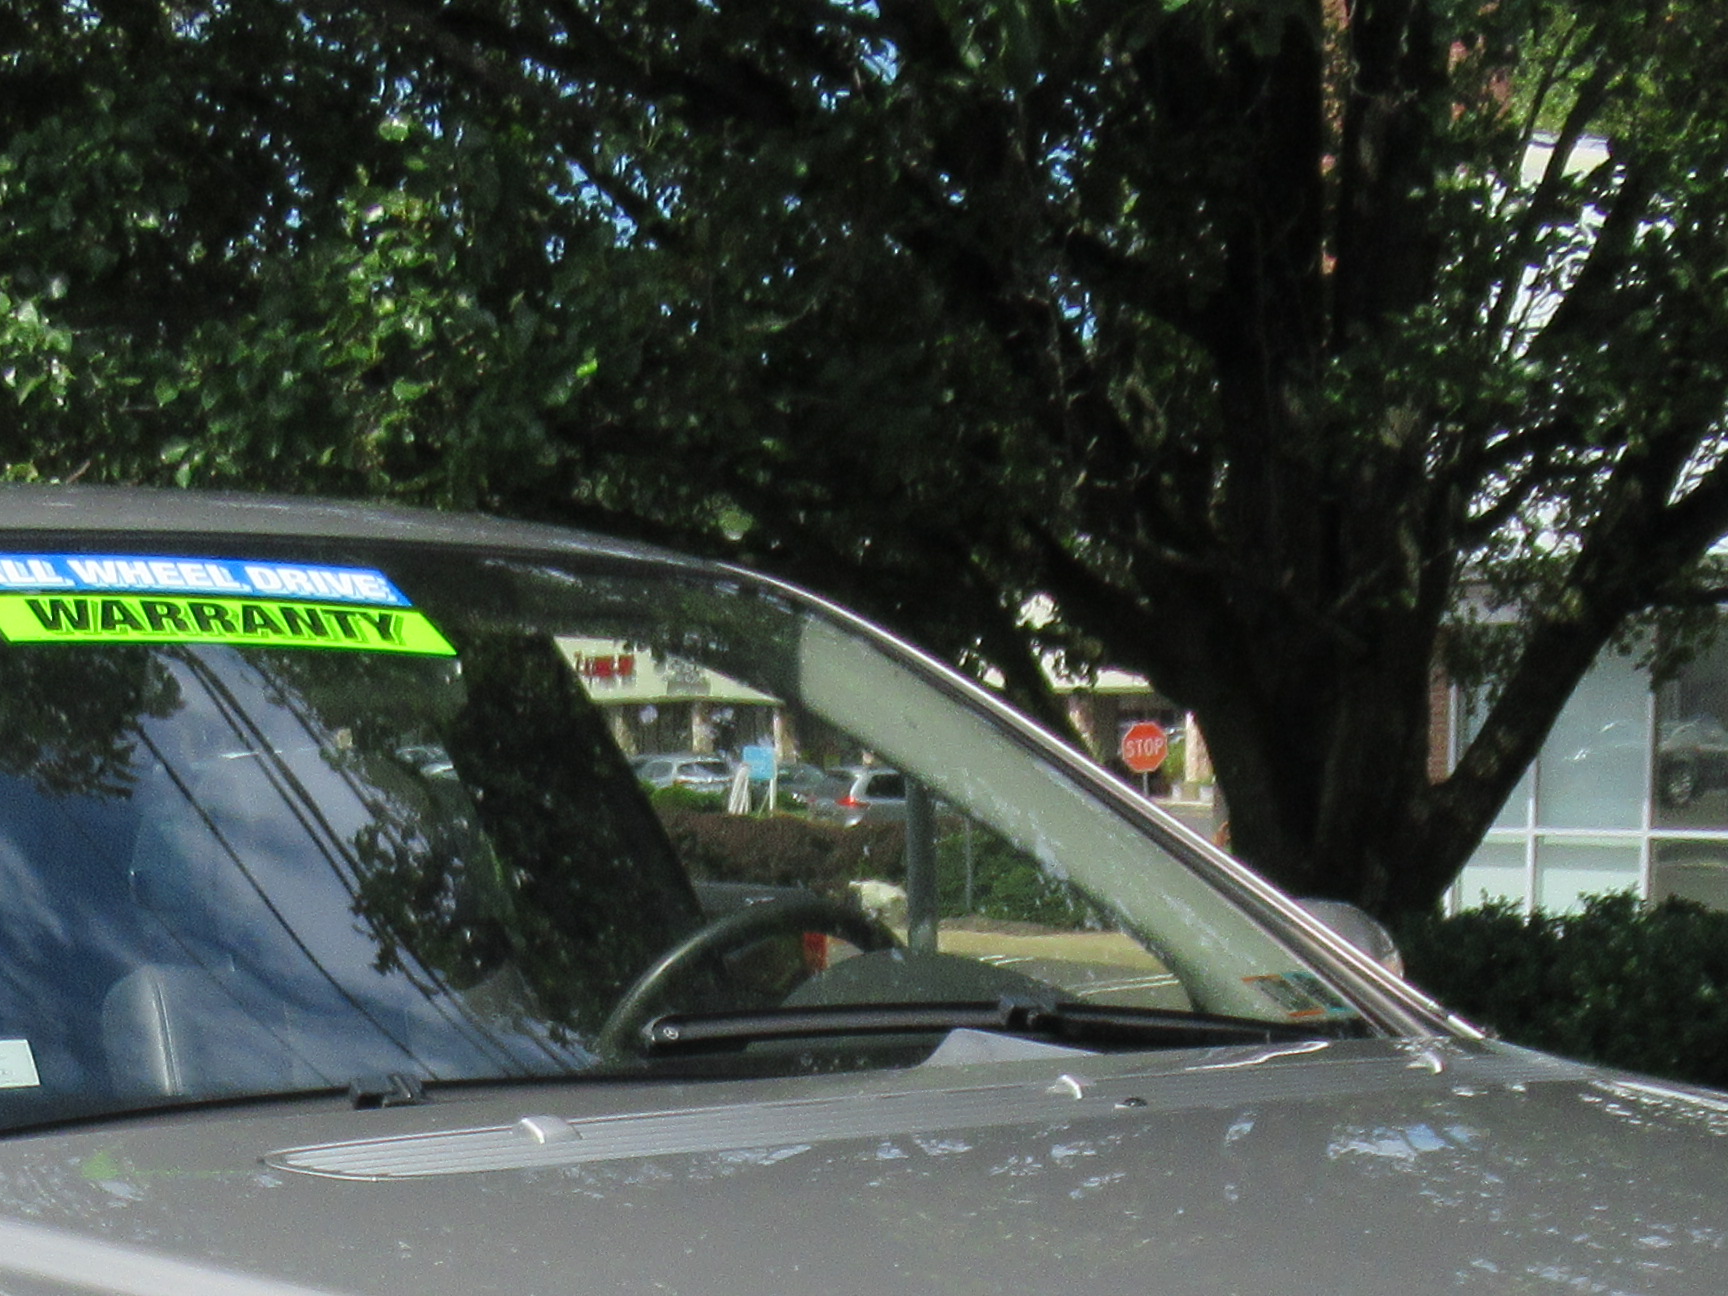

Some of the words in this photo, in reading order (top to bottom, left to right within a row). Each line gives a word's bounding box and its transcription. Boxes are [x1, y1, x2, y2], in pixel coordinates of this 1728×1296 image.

[67, 560, 251, 593] WHEEL
[244, 565, 398, 603] DRIVE
[24, 599, 407, 647] WARRANTY
[1126, 738, 1164, 758] STOP
